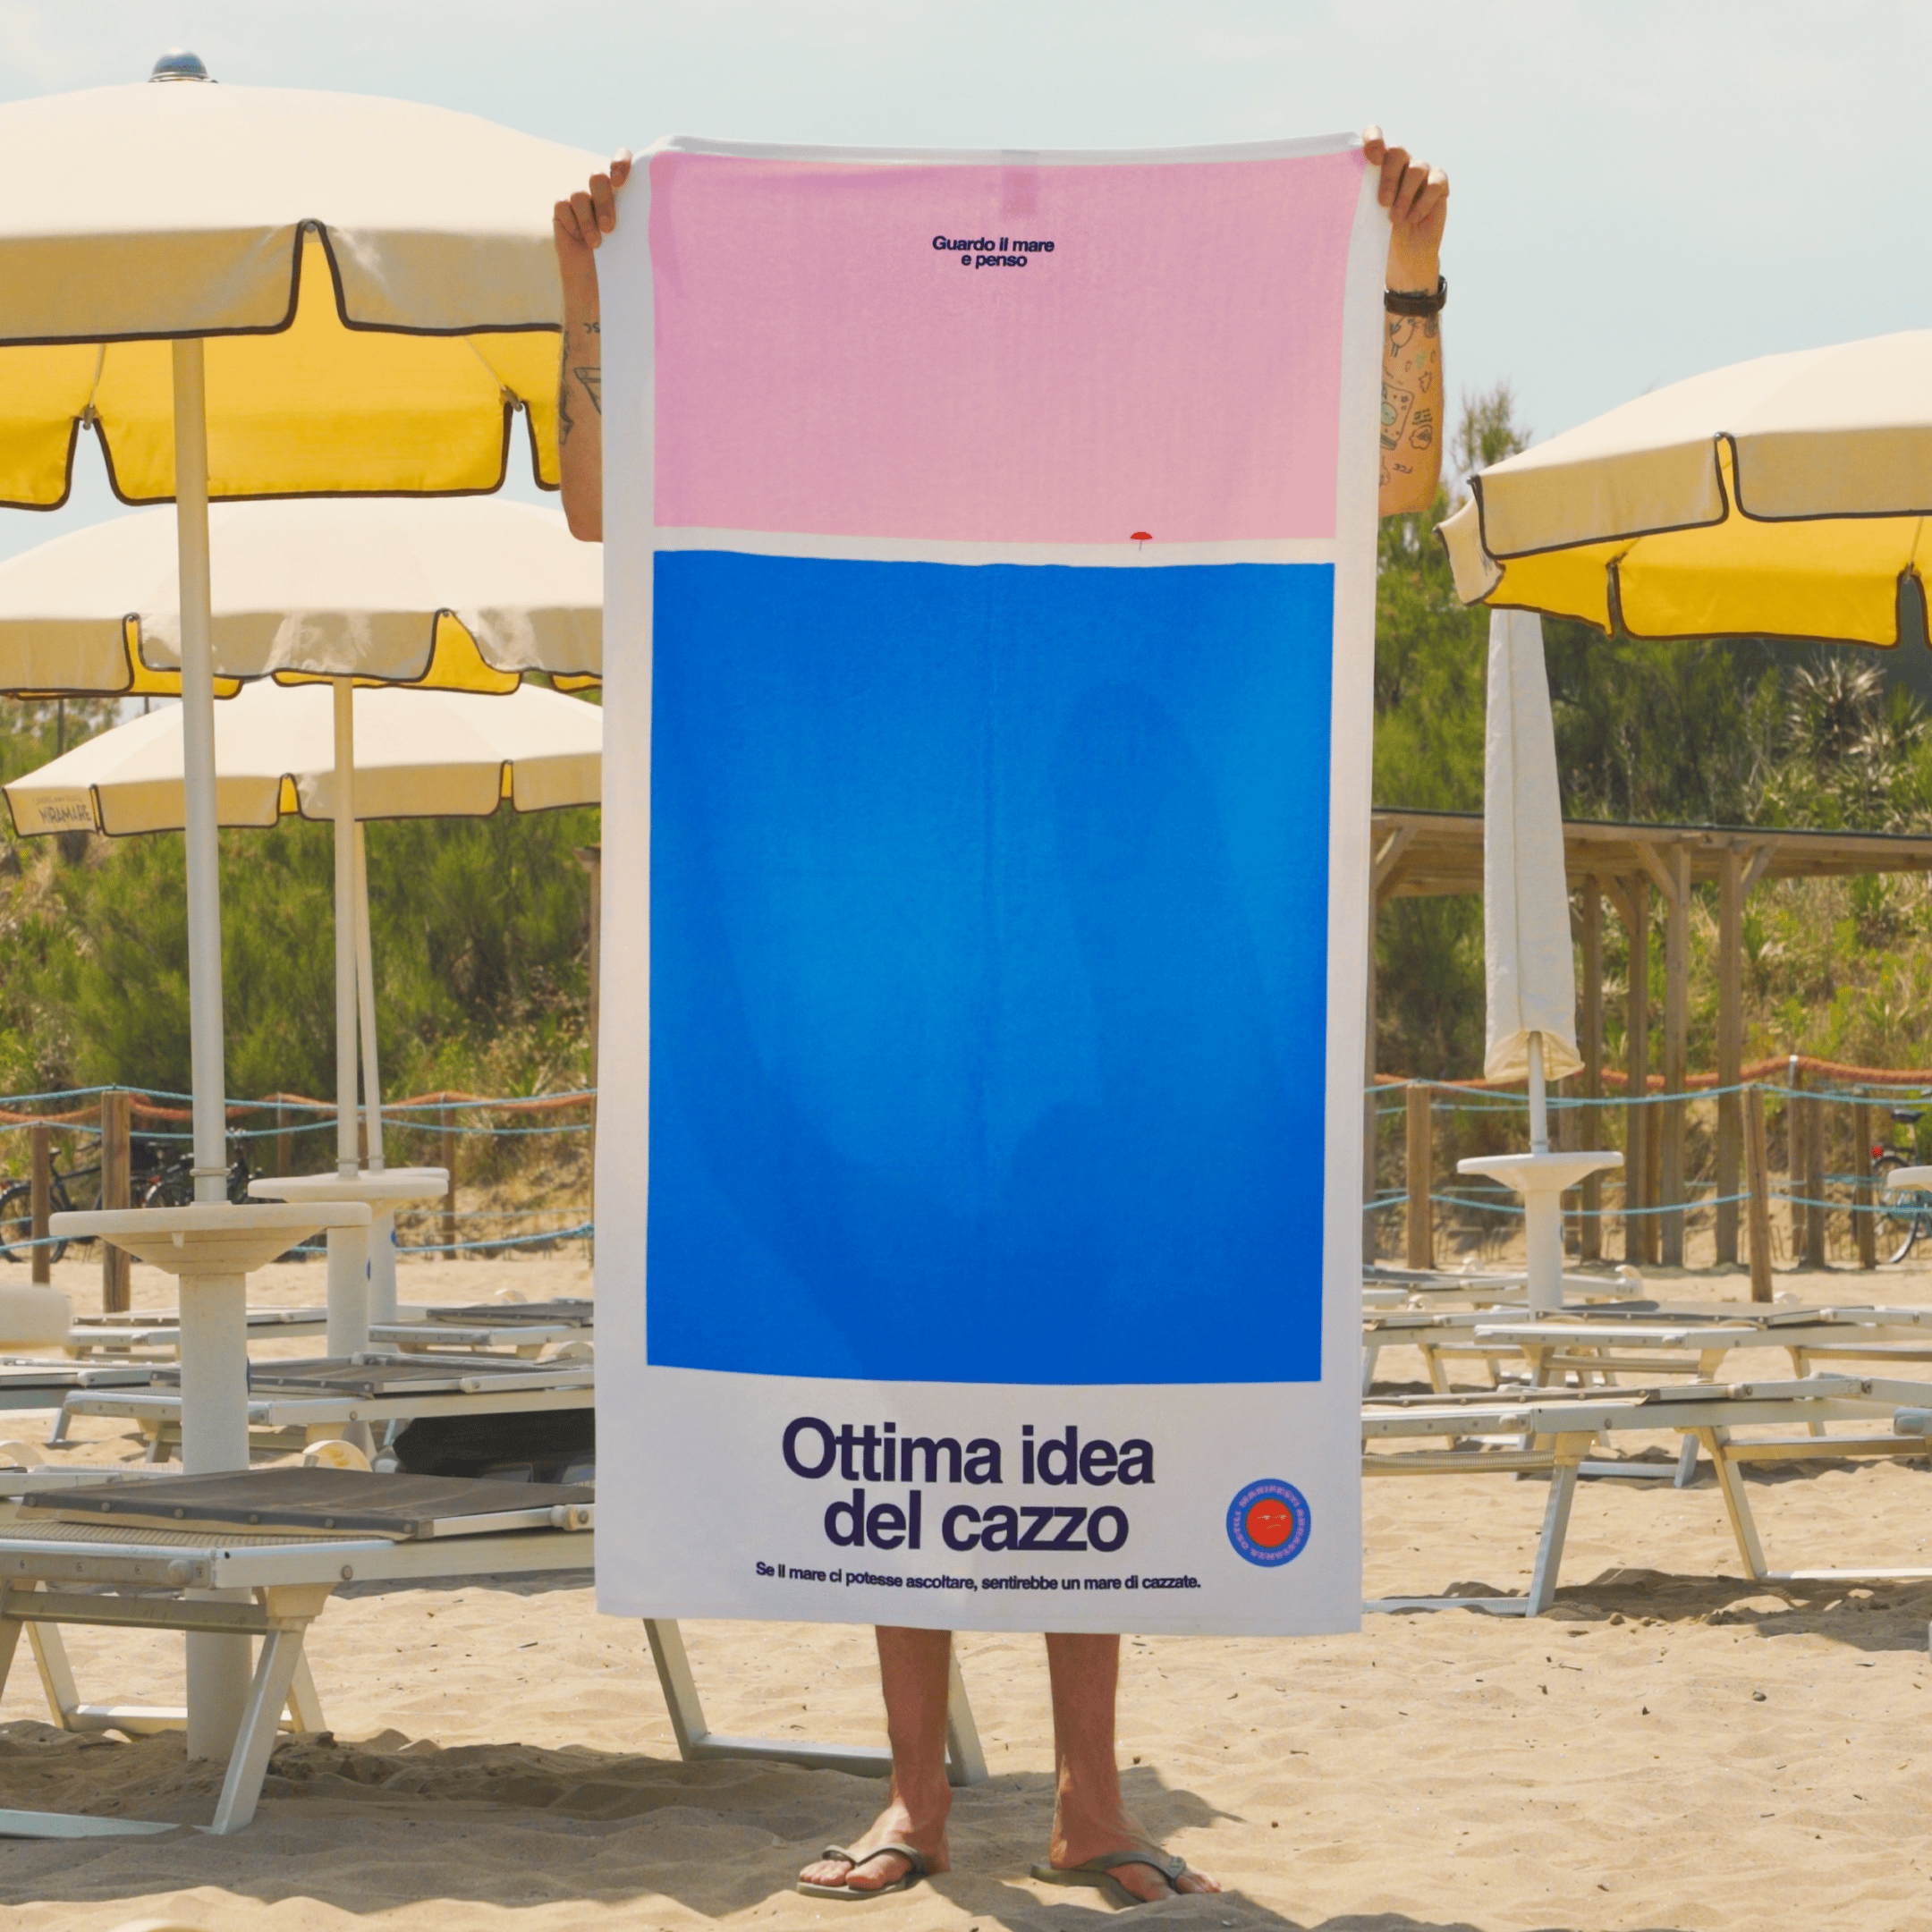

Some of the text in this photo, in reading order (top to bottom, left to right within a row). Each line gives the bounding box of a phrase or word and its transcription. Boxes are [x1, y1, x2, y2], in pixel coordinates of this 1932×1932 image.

[932, 235, 1055, 252] Guardo il mare
[961, 254, 1028, 269] e penso
[782, 1417, 1156, 1487] Ottima idea
[824, 1487, 1130, 1553] del cazzo
[756, 1561, 1201, 1591] Se il mare ci potesse ascoltare, sentirebbe un mare di cazzate.
